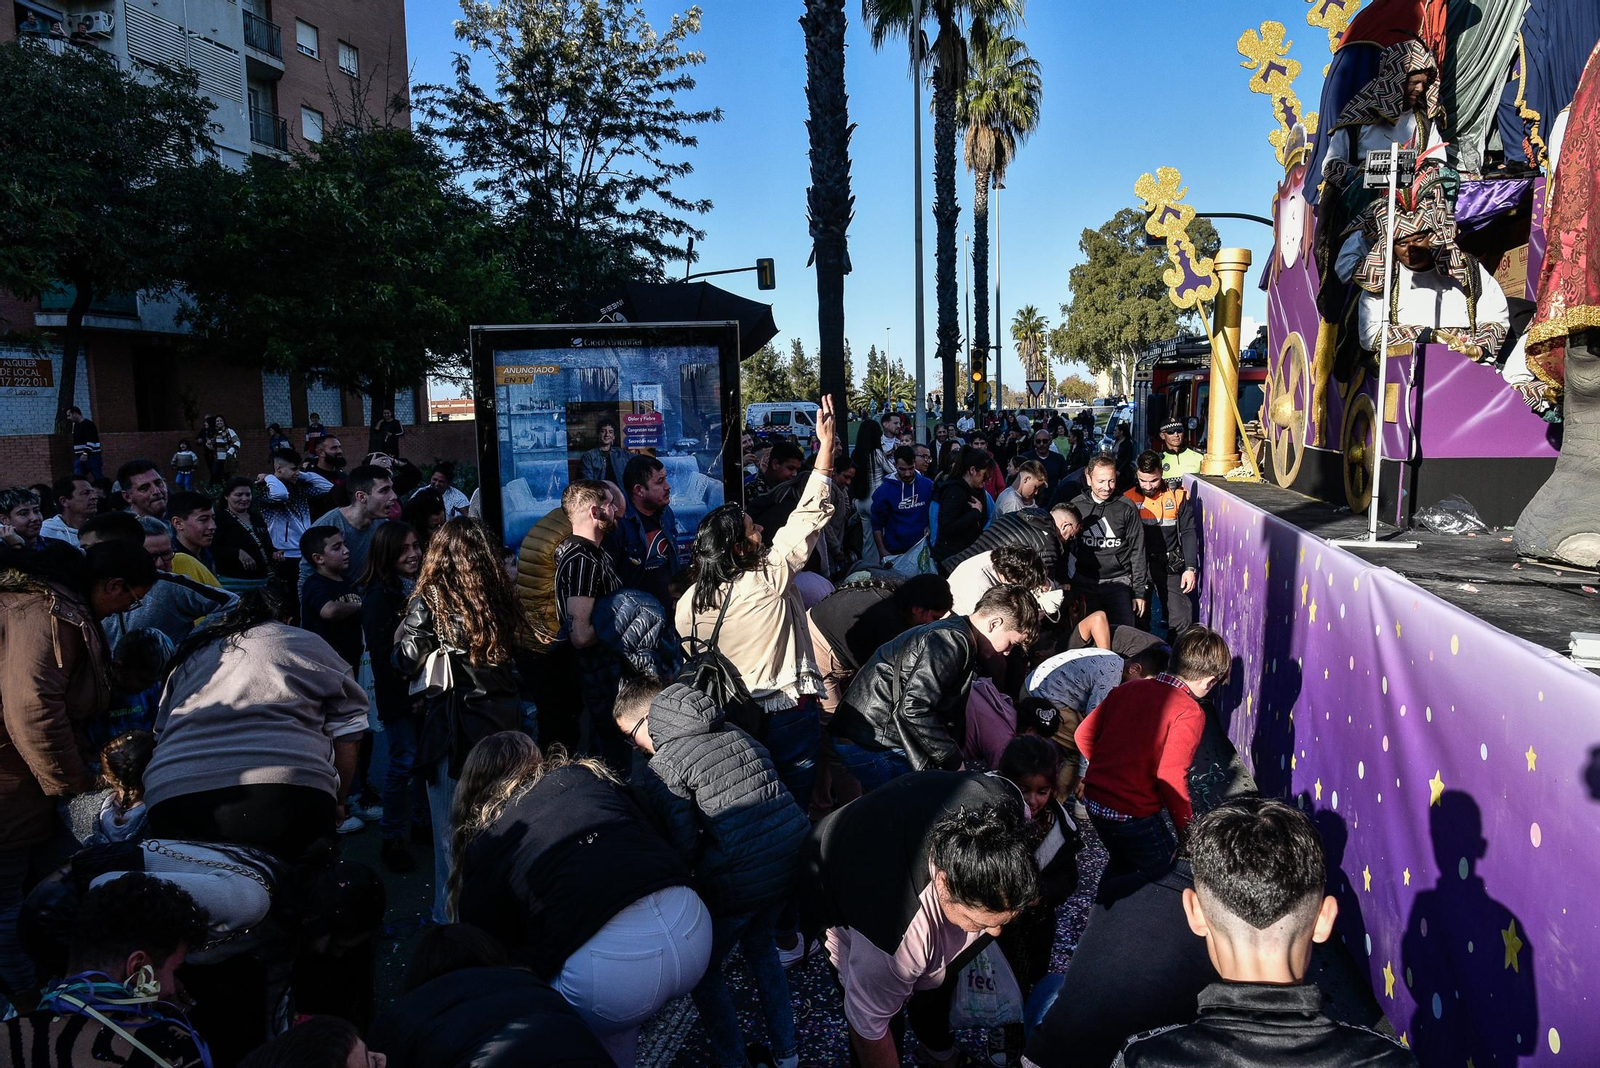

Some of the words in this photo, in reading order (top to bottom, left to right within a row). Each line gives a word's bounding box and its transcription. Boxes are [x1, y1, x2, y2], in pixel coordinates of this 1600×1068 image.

[0, 368, 11, 376] DE
[13, 368, 41, 377] LOCAL
[503, 366, 555, 374] ANUNCIADO
[14, 378, 31, 387] 222
[33, 378, 48, 387] 011
